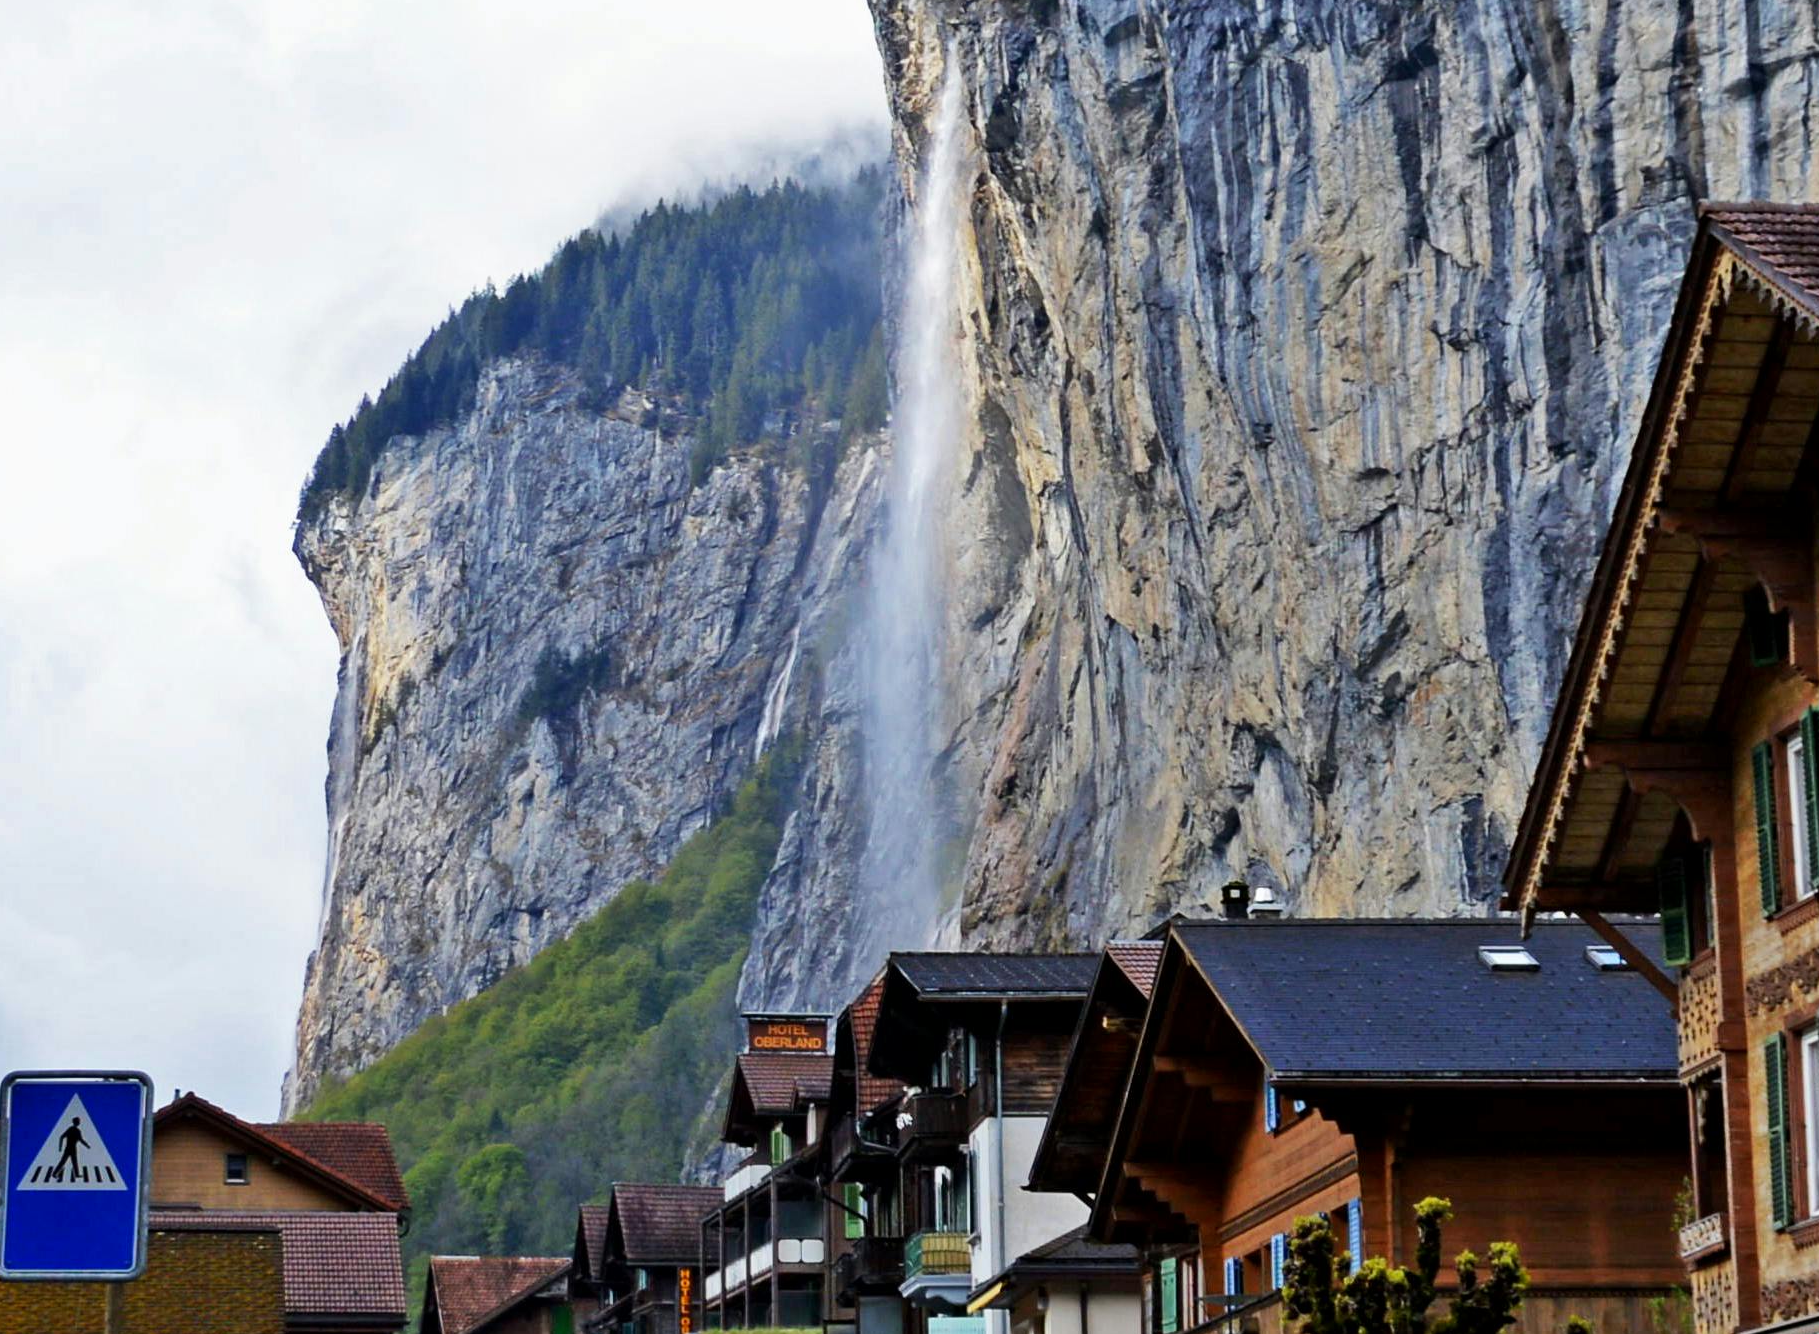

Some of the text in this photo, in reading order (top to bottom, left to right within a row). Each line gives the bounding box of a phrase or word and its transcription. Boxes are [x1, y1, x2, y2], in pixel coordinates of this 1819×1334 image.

[767, 1024, 809, 1035] HOTEL
[754, 1036, 822, 1049] OBERLAND
[680, 1269, 690, 1314] HOTEL
